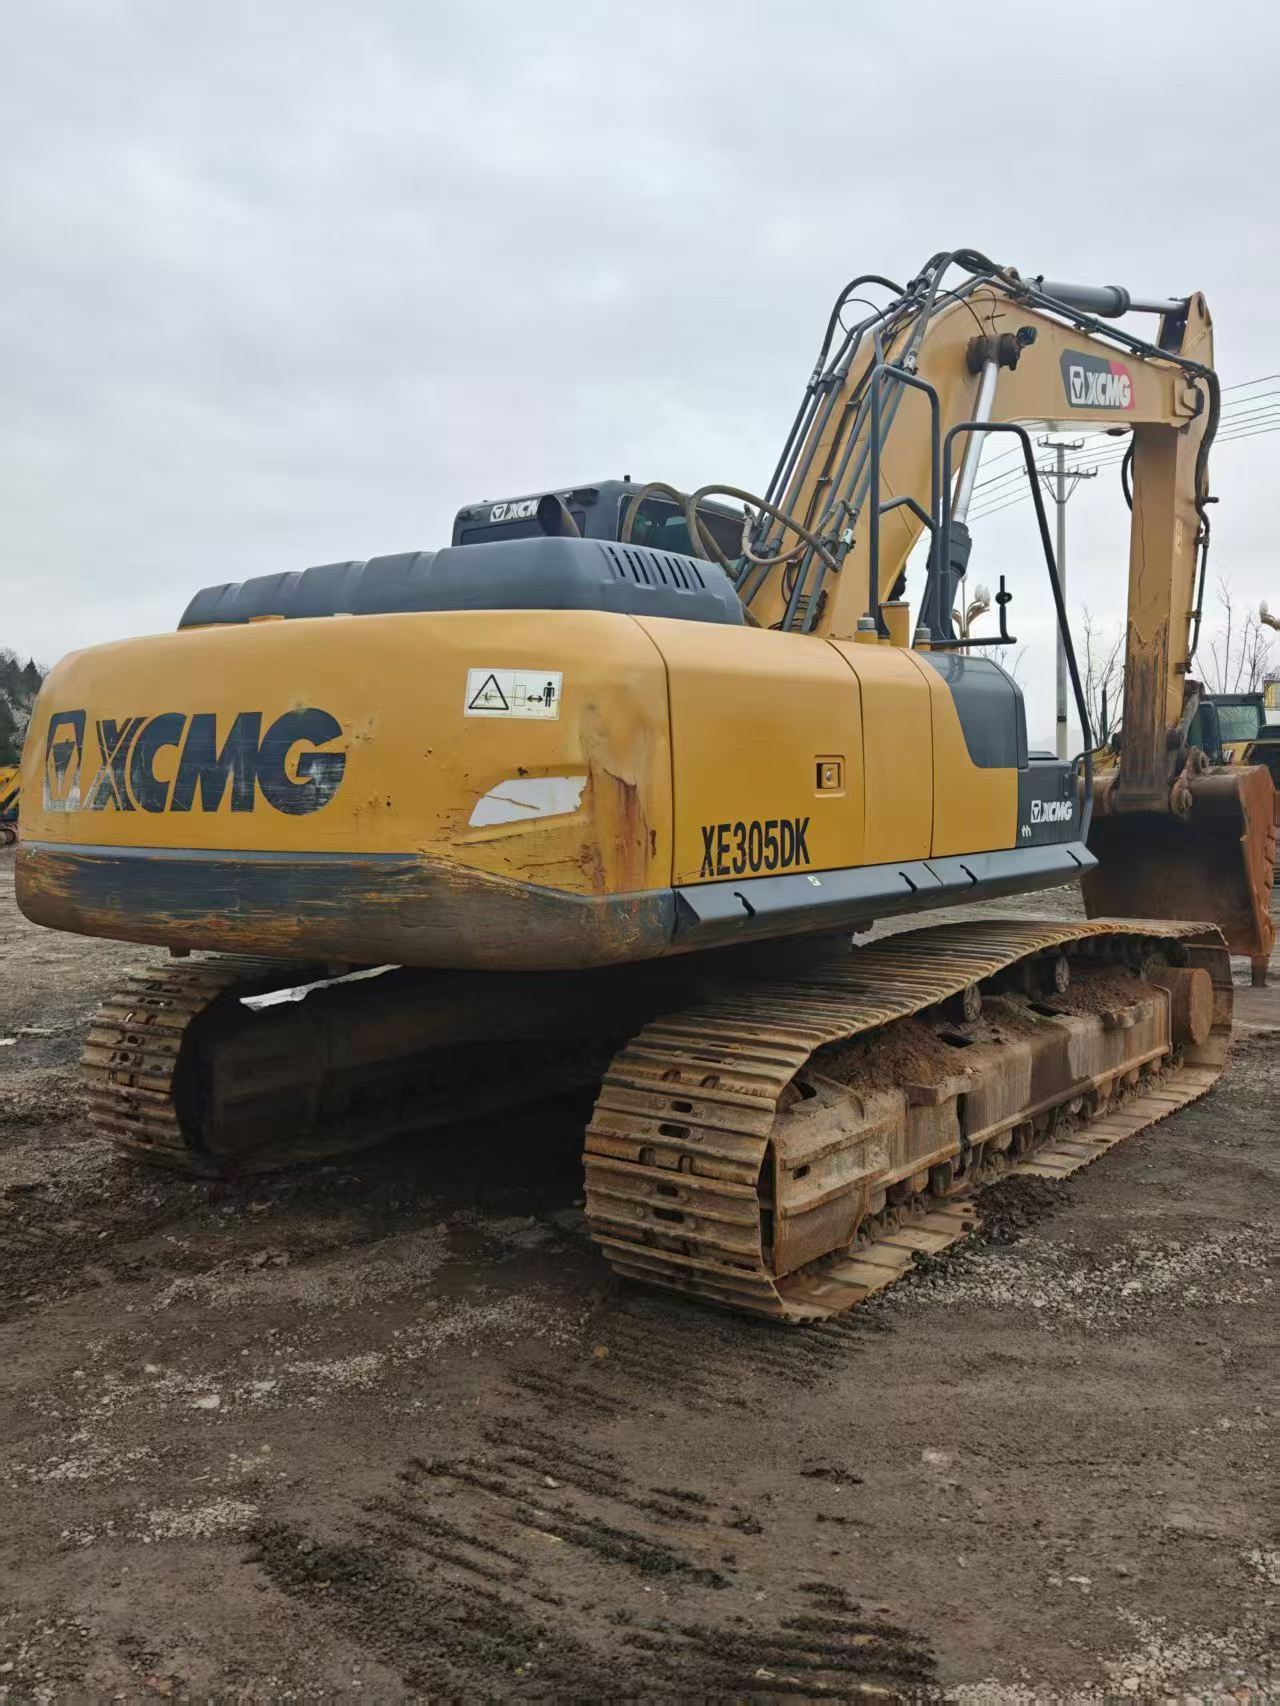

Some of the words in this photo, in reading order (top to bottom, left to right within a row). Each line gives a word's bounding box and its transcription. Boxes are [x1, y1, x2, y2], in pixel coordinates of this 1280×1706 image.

[1085, 372, 1131, 407] XCMG
[505, 499, 540, 520] XCM
[81, 707, 346, 816] XCMG
[1040, 801, 1073, 822] XCMG
[700, 816, 811, 878] XE305DK
